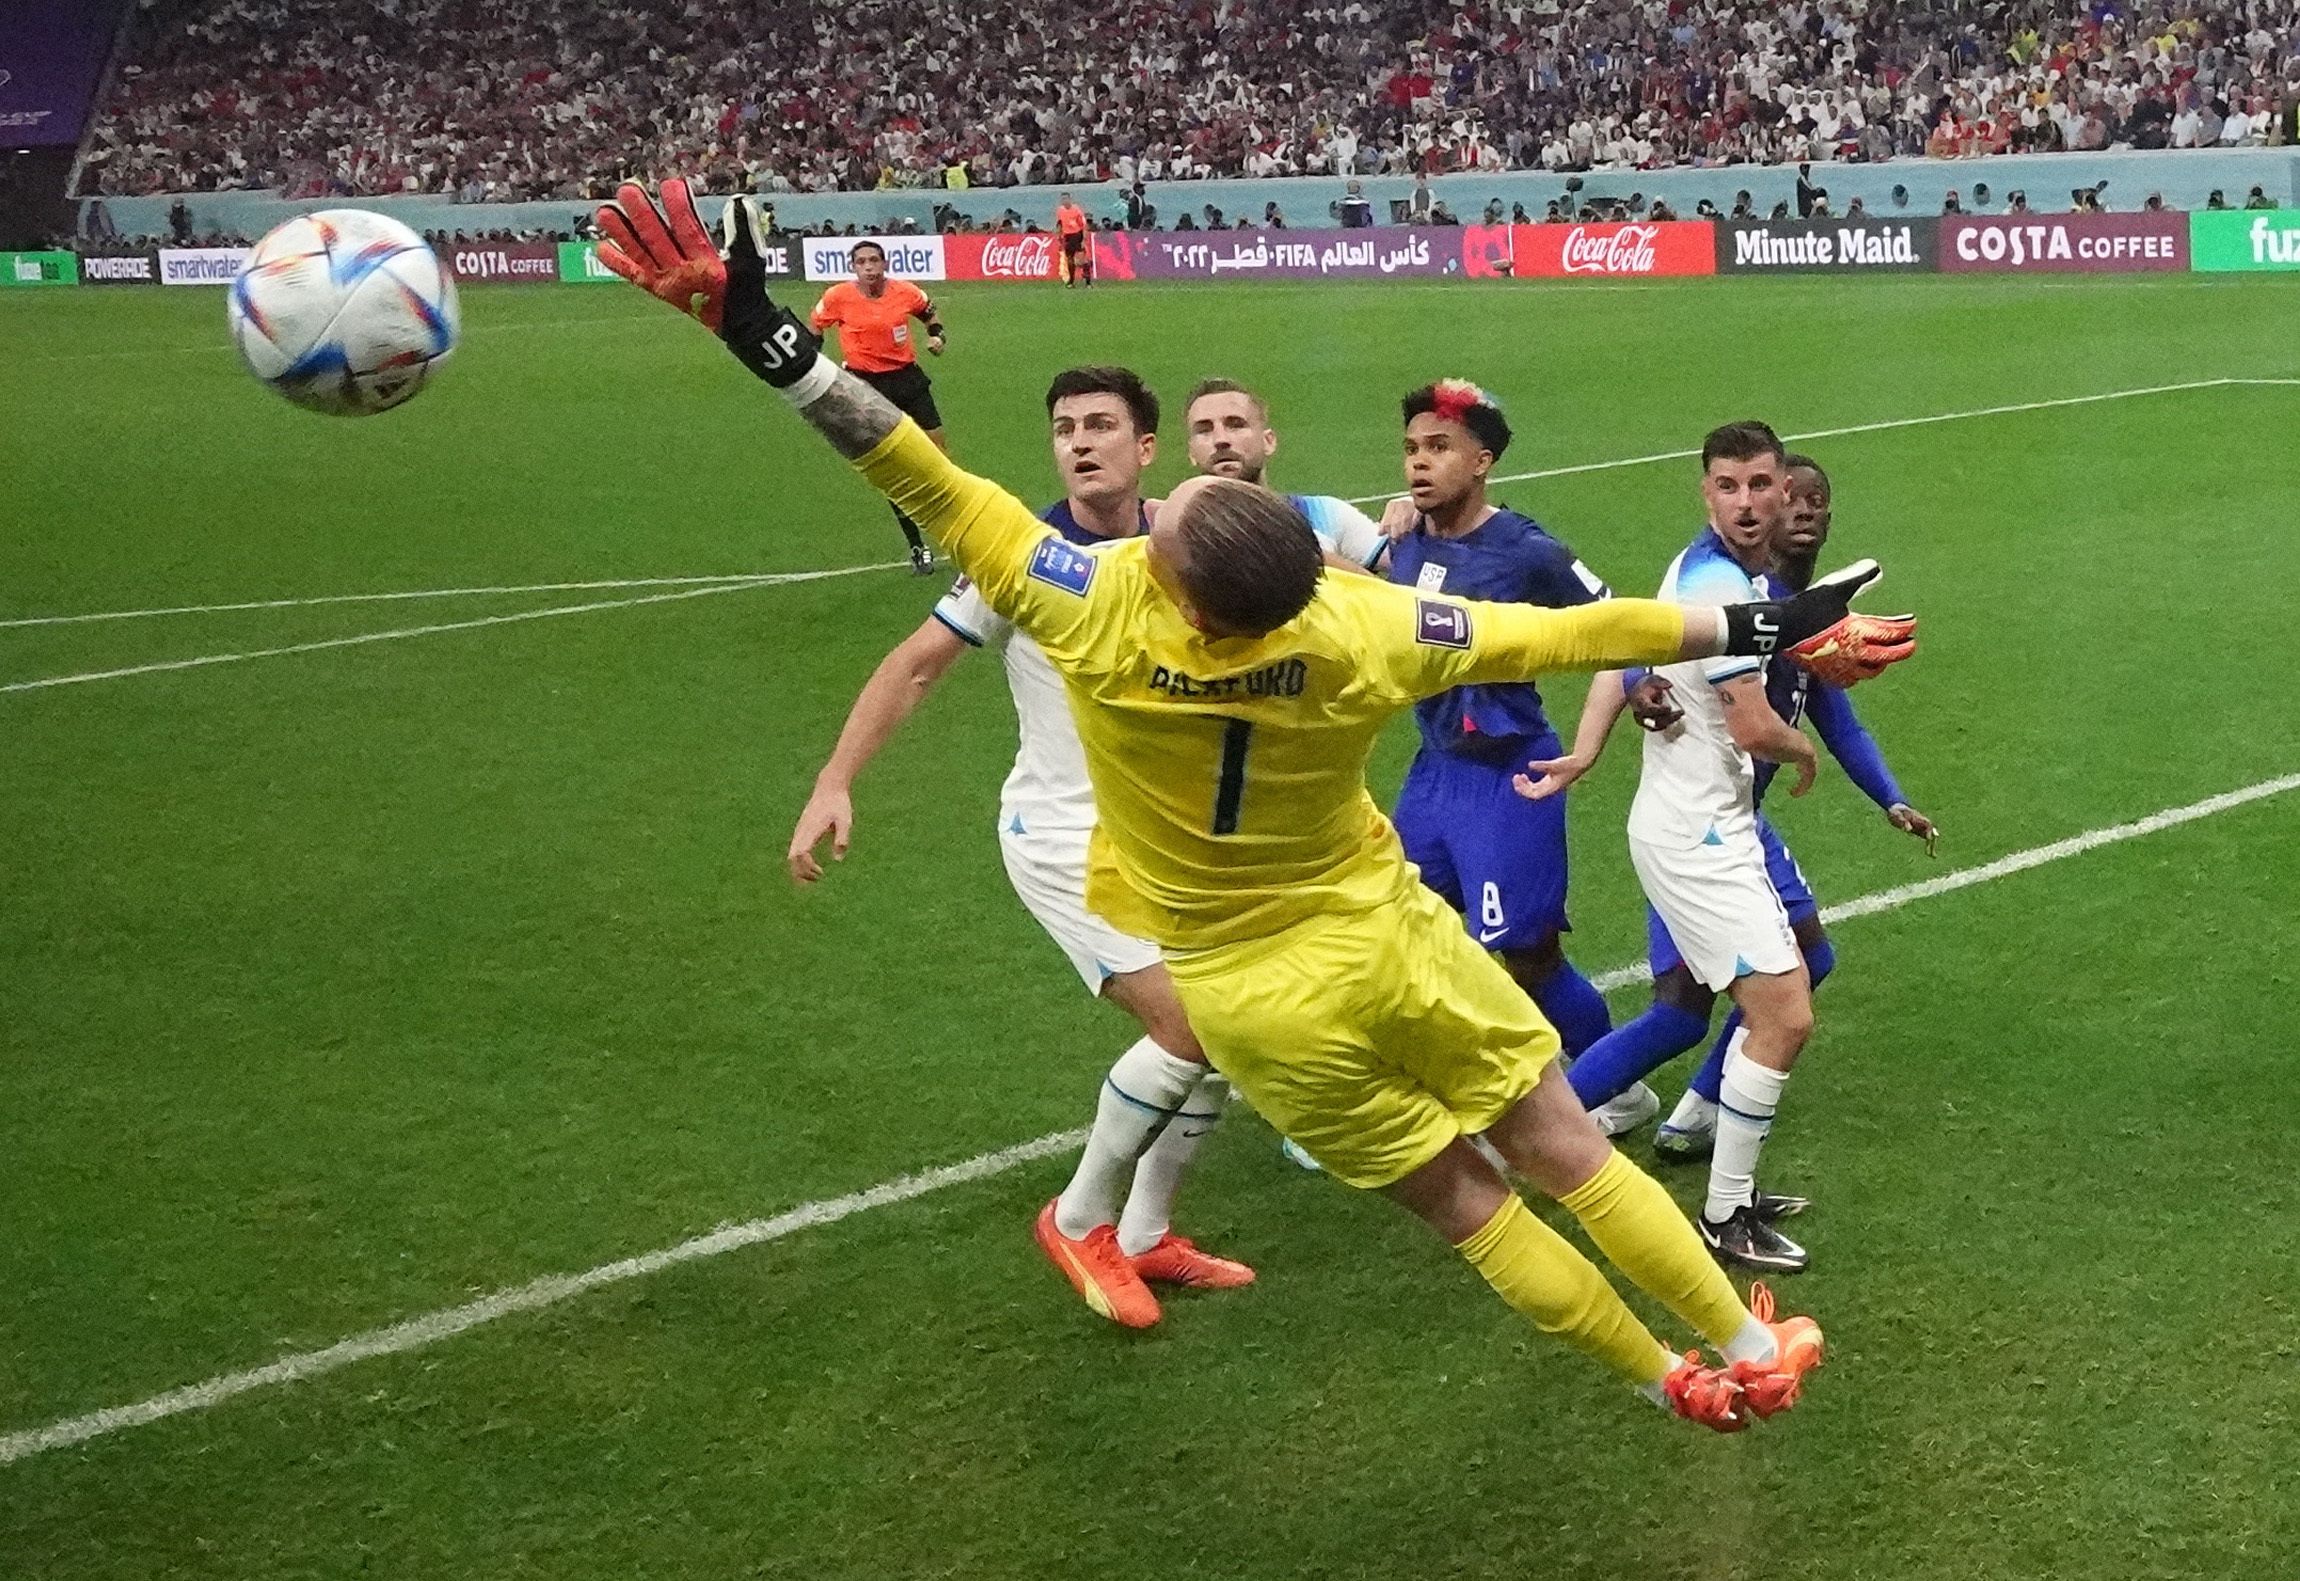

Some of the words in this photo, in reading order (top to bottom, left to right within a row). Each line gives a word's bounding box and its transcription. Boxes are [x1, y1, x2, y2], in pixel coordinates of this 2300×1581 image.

[455, 251, 509, 277] COSTA
[511, 258, 554, 273] COFFEE
[815, 244, 934, 274] smaater
[982, 236, 1054, 276] Coca-Cola
[1211, 236, 1268, 274] قطر
[1276, 244, 1317, 267] FIFA
[1321, 241, 1375, 273] العالم
[1380, 234, 1430, 273] كأس
[1562, 225, 1660, 272] Coca-Cola
[1735, 229, 1833, 265] Minute
[1956, 226, 2073, 265] COSTA
[2078, 236, 2175, 258] COFFEE
[84, 257, 152, 279] POWERADE
[762, 324, 797, 369] JP
[1752, 613, 1779, 652] JP
[1212, 716, 1252, 835] 1
[1482, 881, 1504, 926] 8
